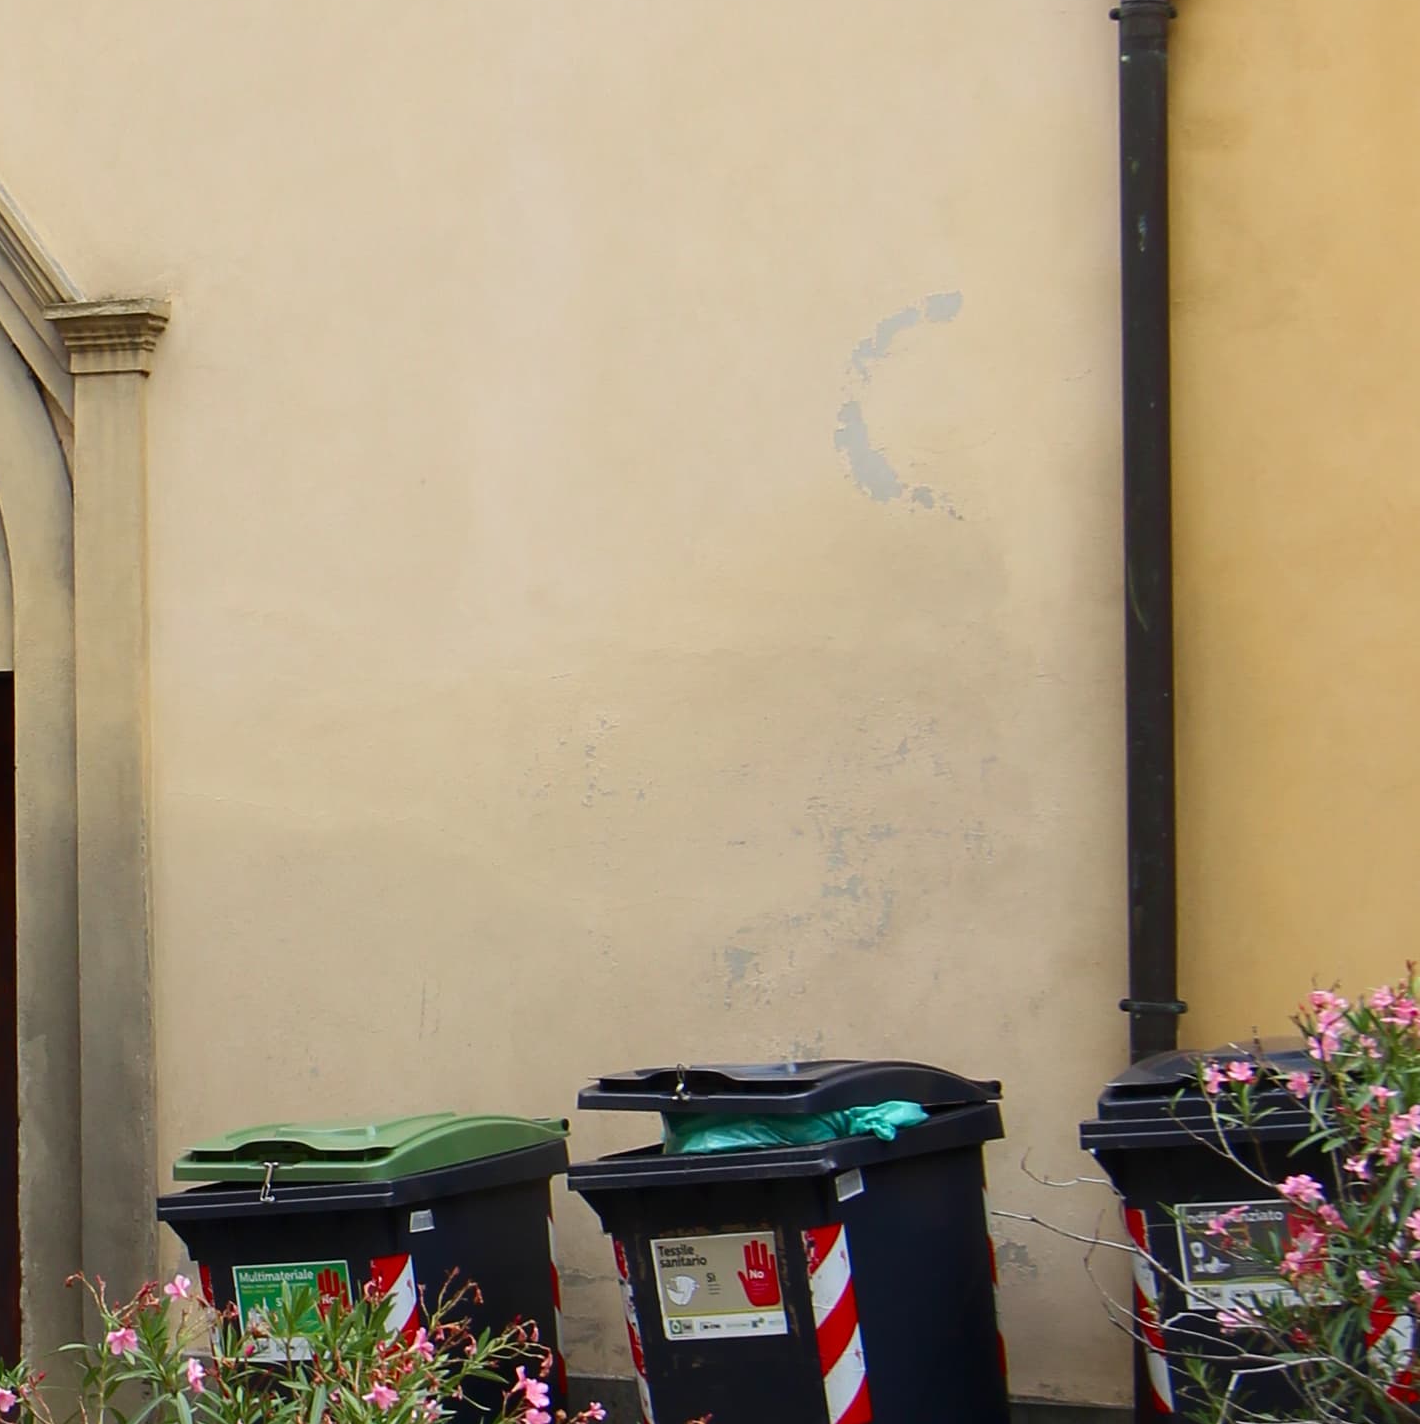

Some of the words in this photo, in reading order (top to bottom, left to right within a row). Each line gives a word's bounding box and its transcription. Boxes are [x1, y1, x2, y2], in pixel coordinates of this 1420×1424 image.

[657, 1244, 695, 1256] Tessile
[660, 1255, 707, 1267] sanitario
[239, 1269, 314, 1282] Multimateriale
[749, 1269, 765, 1279] No
